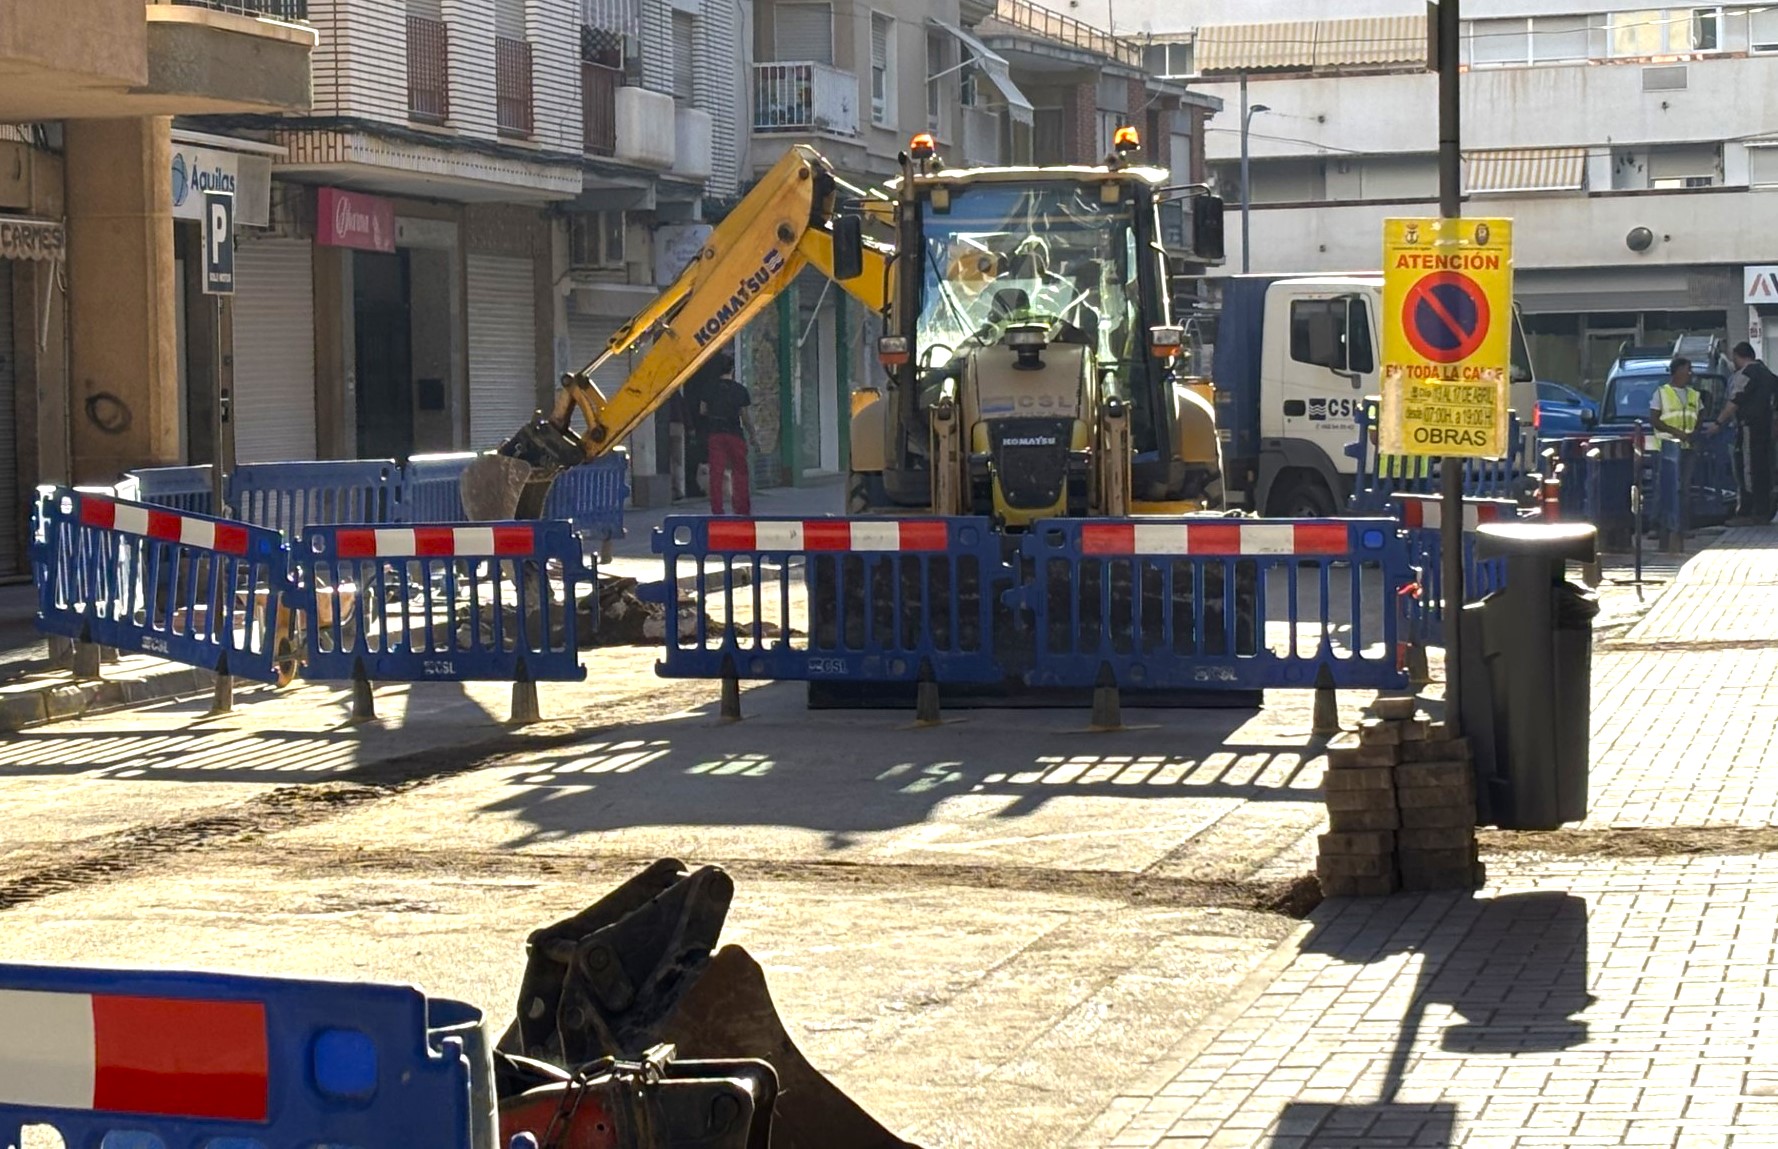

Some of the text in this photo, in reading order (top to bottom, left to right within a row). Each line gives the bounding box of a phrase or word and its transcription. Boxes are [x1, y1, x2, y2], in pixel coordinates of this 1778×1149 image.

[211, 203, 228, 264] P
[1396, 252, 1500, 270] ATENCIÓN
[693, 266, 770, 347] KOMATSU
[1407, 366, 1439, 378] TODA
[1443, 366, 1459, 379] LA
[1018, 395, 1072, 408] CSL
[1003, 436, 1056, 446] KOMATSU
[1414, 427, 1487, 447] OBRAS
